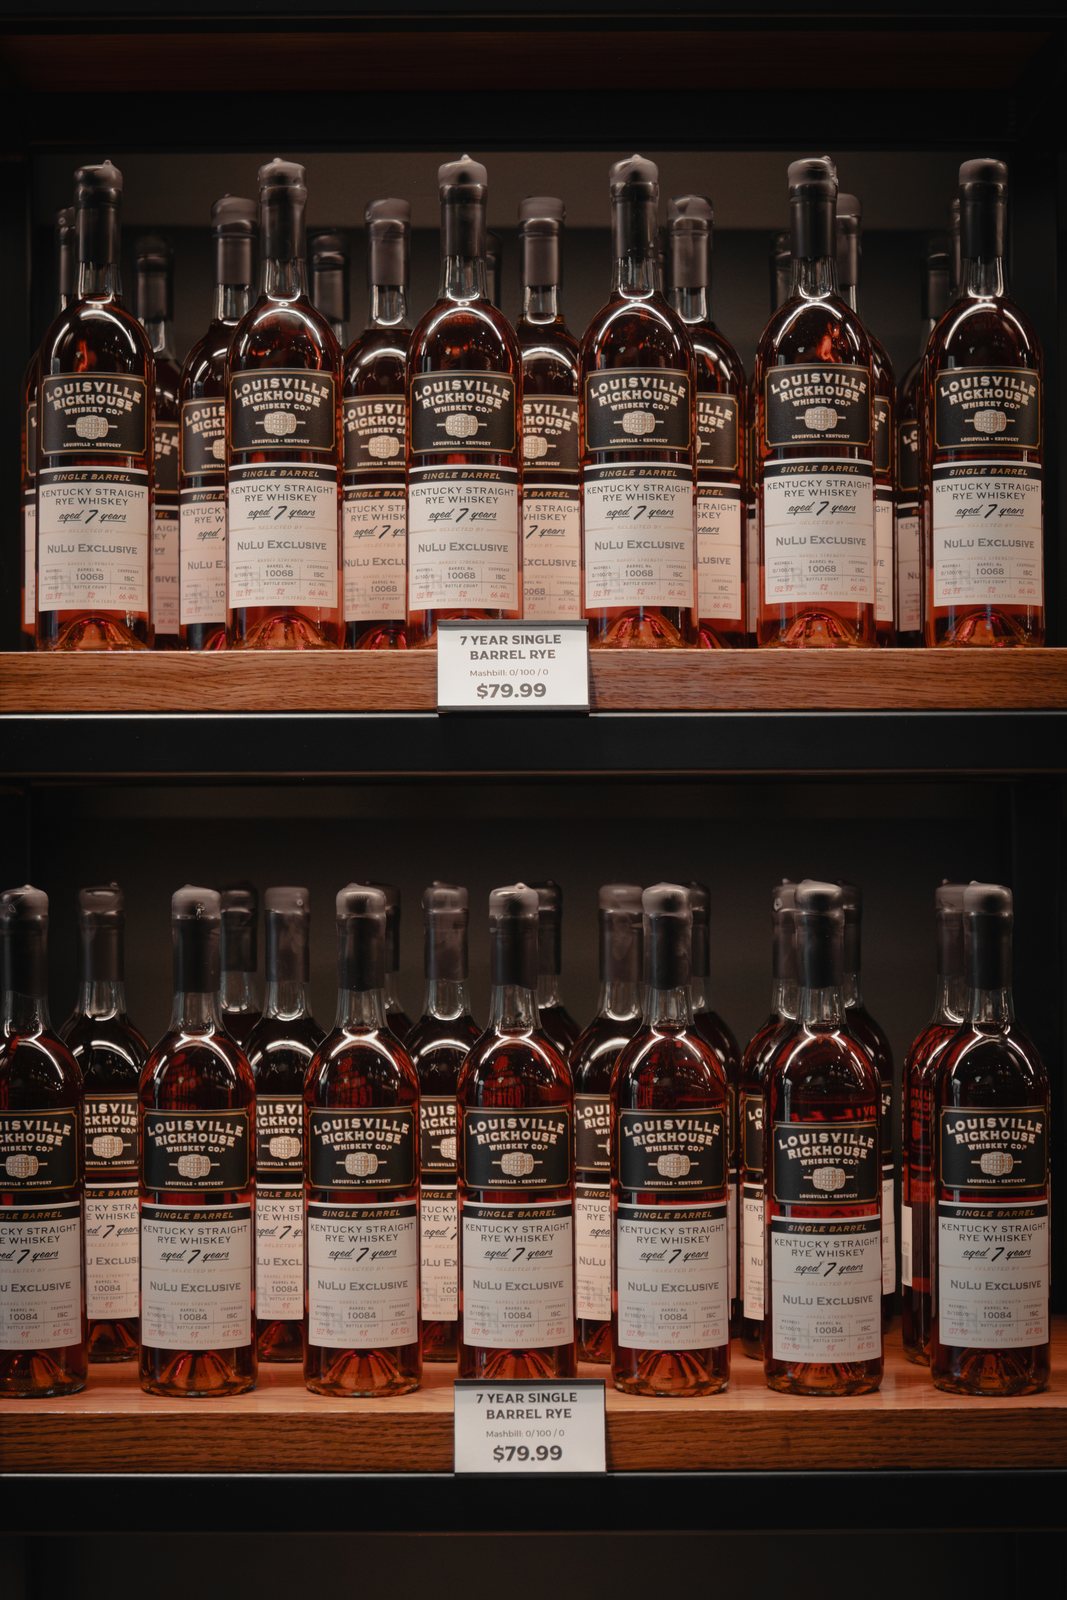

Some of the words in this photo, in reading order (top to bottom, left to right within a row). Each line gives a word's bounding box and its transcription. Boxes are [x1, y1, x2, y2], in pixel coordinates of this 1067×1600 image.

[234, 378, 329, 399] LOUISVILLE
[591, 377, 685, 398] LOUISVILLE
[771, 373, 866, 394] LOUISVILLE
[941, 376, 1036, 397] LOUISVILLE
[46, 382, 141, 403] LOUISVILLE
[415, 380, 510, 401] LOUISVILLE
[780, 386, 859, 402] RICKHOUSE
[241, 390, 321, 407] RICKHOUSE
[423, 392, 502, 409] RICKHOUSE
[600, 390, 679, 407] RICKHOUSE
[950, 388, 1029, 405] RICKHOUSE
[53, 394, 133, 411] RICKHOUSE
[242, 470, 276, 478] SINGLE
[782, 465, 817, 473] SINGLE
[951, 468, 986, 476] SINGLE
[423, 472, 458, 480] SINGLE
[231, 485, 280, 495] KENTUCKY
[284, 485, 334, 494] STRAIGHT
[587, 485, 639, 495] KENTUCKY
[643, 485, 690, 494] STRAIGHT
[767, 480, 822, 490] KENTUCKY
[826, 480, 871, 489] STRAIGHT
[936, 483, 990, 493] KENTUCKY
[994, 483, 1039, 492] STRAIGHT
[42, 488, 92, 498] KENTUCKY
[96, 489, 145, 498] STRAIGHT
[348, 490, 381, 498] SINGLE
[412, 487, 462, 497] KENTUCKY
[466, 487, 514, 496] STRAIGHT
[785, 490, 803, 498] RYE
[809, 489, 857, 497] WHISKEY
[953, 492, 971, 500] RYE
[977, 492, 1026, 500] WHISKEY
[56, 498, 74, 506] RYE
[78, 498, 128, 506] WHISKEY
[245, 494, 263, 502] RYE
[267, 494, 317, 502] WHISKEY
[426, 496, 444, 504] RYE
[448, 496, 499, 504] WHISKEY
[603, 494, 621, 502] RYE
[626, 493, 676, 501] WHISKEY
[787, 502, 814, 516] aged
[816, 501, 829, 516] 7
[829, 504, 857, 514] years
[58, 510, 84, 524] aged
[85, 509, 98, 524] 7
[99, 512, 126, 523] years
[808, 565, 836, 573] 10068
[460, 636, 467, 645] 7
[471, 636, 508, 645] YEAR
[512, 635, 562, 644] SINGLE
[470, 651, 526, 660] BARREL
[530, 650, 556, 659] RYE
[476, 683, 546, 699] $79.99
[147, 1120, 243, 1137] LOUISVILLE
[313, 1118, 409, 1135] LOUISVILLE
[469, 1118, 565, 1135] LOUISVILLE
[625, 1120, 721, 1137] LOUISVILLE
[947, 1118, 1042, 1135] LOUISVILLE
[155, 1133, 235, 1147] RICKHOUSE
[321, 1131, 402, 1145] RICKHOUSE
[477, 1131, 557, 1145] RICKHOUSE
[633, 1133, 713, 1146] RICKHOUSE
[779, 1133, 874, 1150] LOUISVILLE
[956, 1131, 1036, 1144] RICKHOUSE
[788, 1146, 867, 1159] RICKHOUSE
[194, 1212, 233, 1220] BARREL
[322, 1210, 358, 1218] SINGLE
[362, 1210, 400, 1218] BARREL
[478, 1210, 514, 1218] SINGLE
[518, 1210, 556, 1218] BARREL
[674, 1211, 712, 1219] BARREL
[996, 1209, 1035, 1217] BARREL
[27, 1223, 76, 1235] STRAIGHT
[143, 1226, 195, 1235] KENTUCKY
[198, 1225, 246, 1235] STRAIGHT
[310, 1224, 363, 1233] KENTUCKY
[366, 1223, 413, 1233] STRAIGHT
[465, 1224, 519, 1233] KENTUCKY
[522, 1223, 570, 1233] STRAIGHT
[621, 1226, 675, 1235] KENTUCKY
[678, 1224, 726, 1234] STRAIGHT
[828, 1224, 866, 1232] BARREL
[942, 1223, 998, 1232] KENTUCKY
[1001, 1222, 1046, 1233] STRAIGHT
[10, 1236, 60, 1244] WHISKEY
[157, 1236, 177, 1244] RYE
[180, 1236, 231, 1244] WHISKEY
[348, 1234, 399, 1242] WHISKEY
[504, 1234, 555, 1242] WHISKEY
[637, 1236, 657, 1244] RYE
[660, 1236, 711, 1244] WHISKEY
[775, 1239, 830, 1248] KENTUCKY
[833, 1237, 878, 1248] STRAIGHT
[960, 1234, 979, 1242] RYE
[983, 1234, 1034, 1242] WHISKEY
[483, 1248, 511, 1260] aged
[512, 1248, 525, 1262] 7
[526, 1250, 553, 1260] years
[792, 1249, 811, 1257] RYE
[815, 1249, 866, 1257] WHISKEY
[9, 1313, 38, 1321] 10084
[476, 1394, 483, 1404] 7
[487, 1393, 524, 1403] YEAR
[528, 1392, 577, 1402] SINGLE
[486, 1409, 542, 1419] BARREL
[546, 1408, 572, 1418] RYE
[493, 1445, 562, 1462] $79.99
